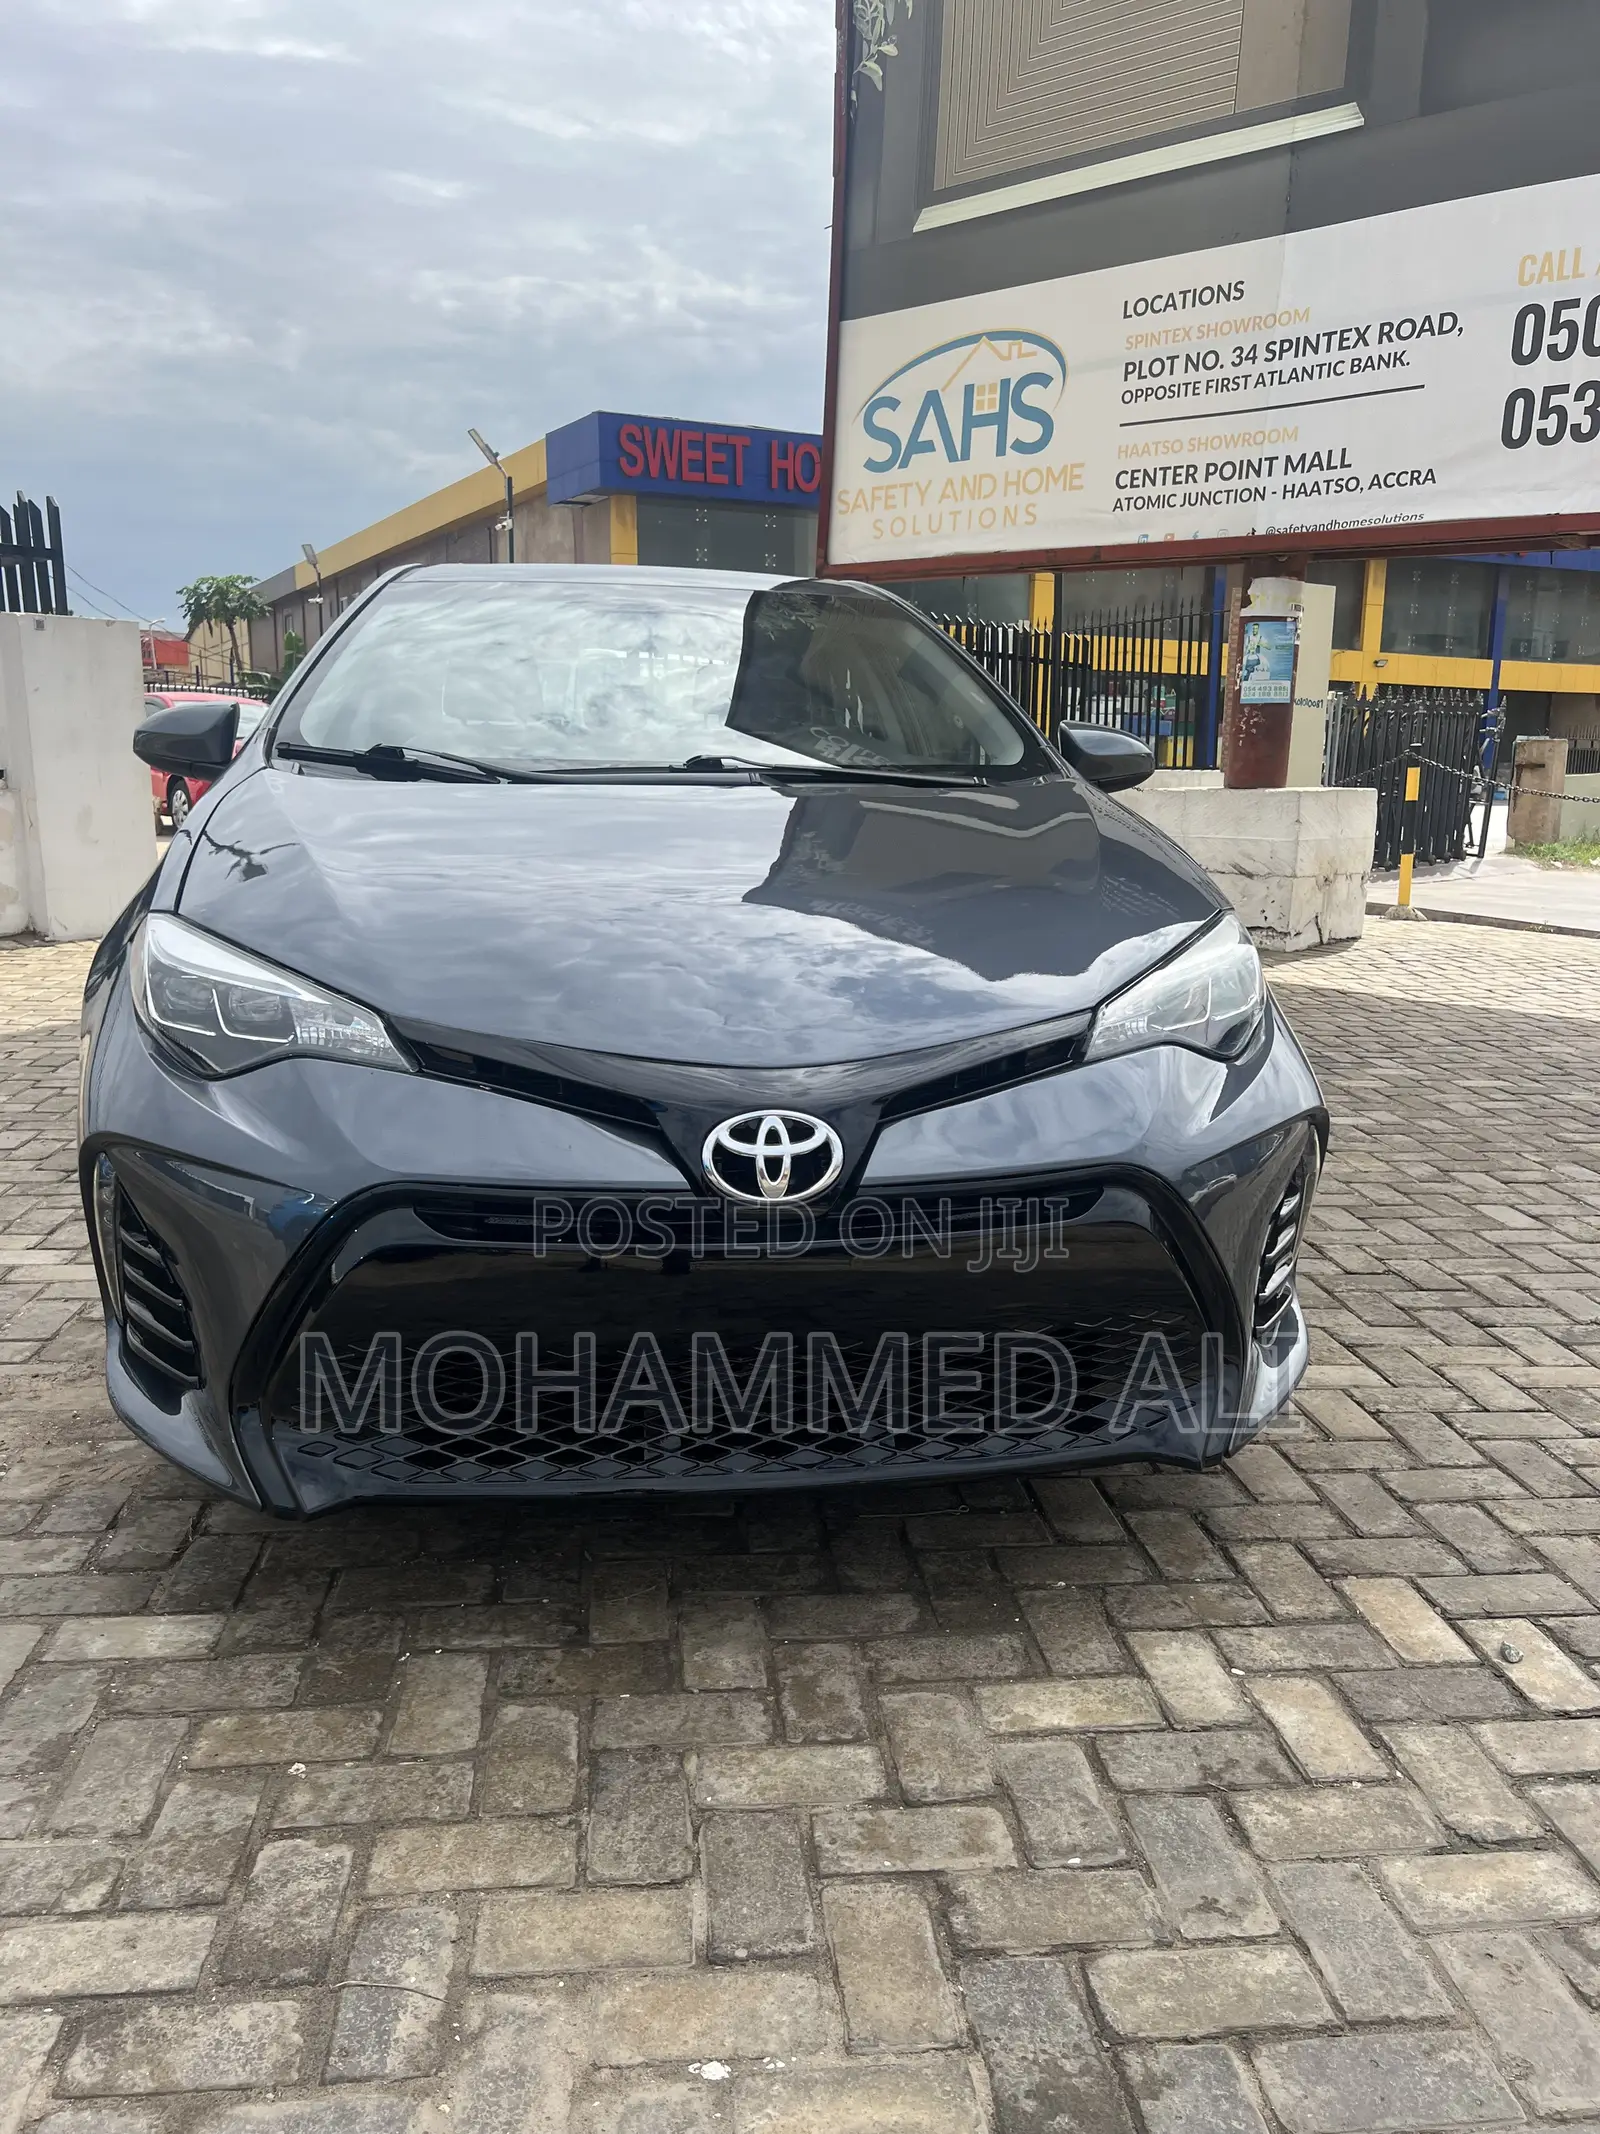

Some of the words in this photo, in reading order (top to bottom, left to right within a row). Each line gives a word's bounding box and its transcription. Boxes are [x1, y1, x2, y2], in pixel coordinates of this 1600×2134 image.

[1517, 247, 1585, 287] CALL
[1123, 280, 1245, 319] LOCATIONS
[1123, 355, 1180, 382] PLOT
[1184, 348, 1225, 371] NO.
[1231, 343, 1259, 367] 34
[1264, 325, 1372, 363] SPINTEX
[1377, 311, 1464, 345] ROAD,
[1125, 325, 1193, 351] SPINTEX
[1196, 306, 1311, 340] SHOWROOM
[1121, 380, 1202, 405] OPPOSITE
[1205, 374, 1252, 395] FIRST
[1253, 360, 1345, 389] ATLANTIC
[1349, 350, 1411, 374] BANK.
[863, 372, 1054, 473] SAHS
[1117, 438, 1183, 460] HAATSO
[1187, 425, 1299, 453] SHOWROOM
[619, 424, 751, 486] SWEET
[1115, 463, 1199, 490] CENTER
[1204, 455, 1279, 483] POINT
[1283, 447, 1352, 476] MALL
[837, 479, 932, 515] SAFETY
[938, 473, 997, 505] AND
[1003, 462, 1085, 497] HOME
[1112, 493, 1177, 513] ATOMIC
[1180, 486, 1266, 508] JUNCTION
[1282, 475, 1364, 500] HAATSO,
[1368, 468, 1437, 491] ACCRA
[873, 503, 1037, 539] SOLUTIONS
